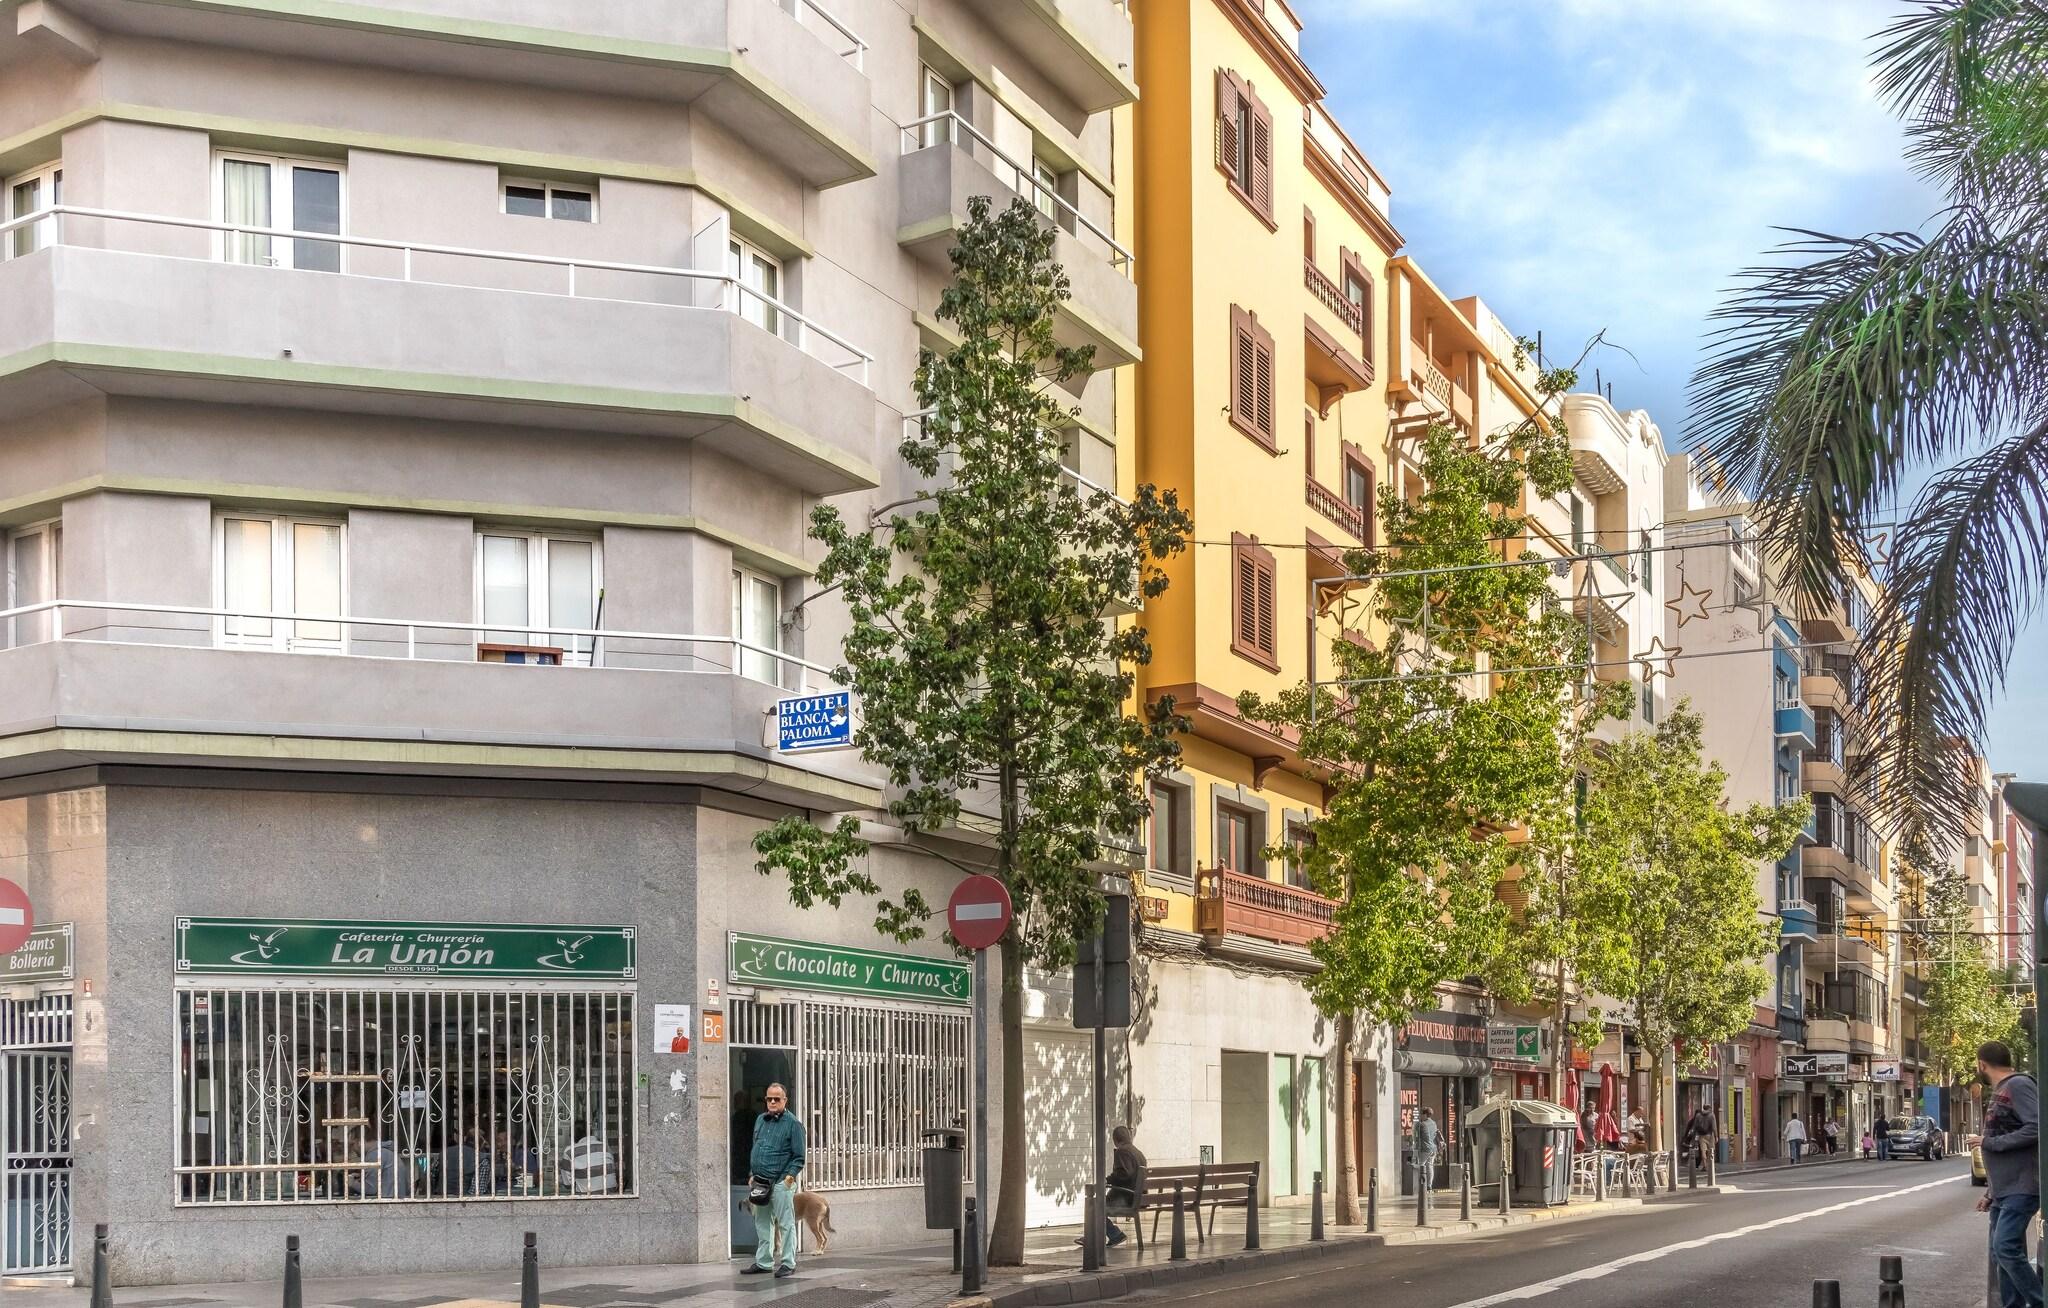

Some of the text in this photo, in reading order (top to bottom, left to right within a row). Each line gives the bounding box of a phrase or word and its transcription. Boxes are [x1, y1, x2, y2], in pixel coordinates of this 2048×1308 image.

[781, 696, 847, 715] HOTEL
[781, 712, 830, 728] BLANCA
[781, 725, 832, 741] PALOMA
[339, 932, 404, 943] Cafetería
[416, 933, 485, 944] Churrería
[9, 951, 55, 970] Bollería
[331, 943, 494, 965] La Unión
[775, 950, 941, 988] Chocolate y Churros
